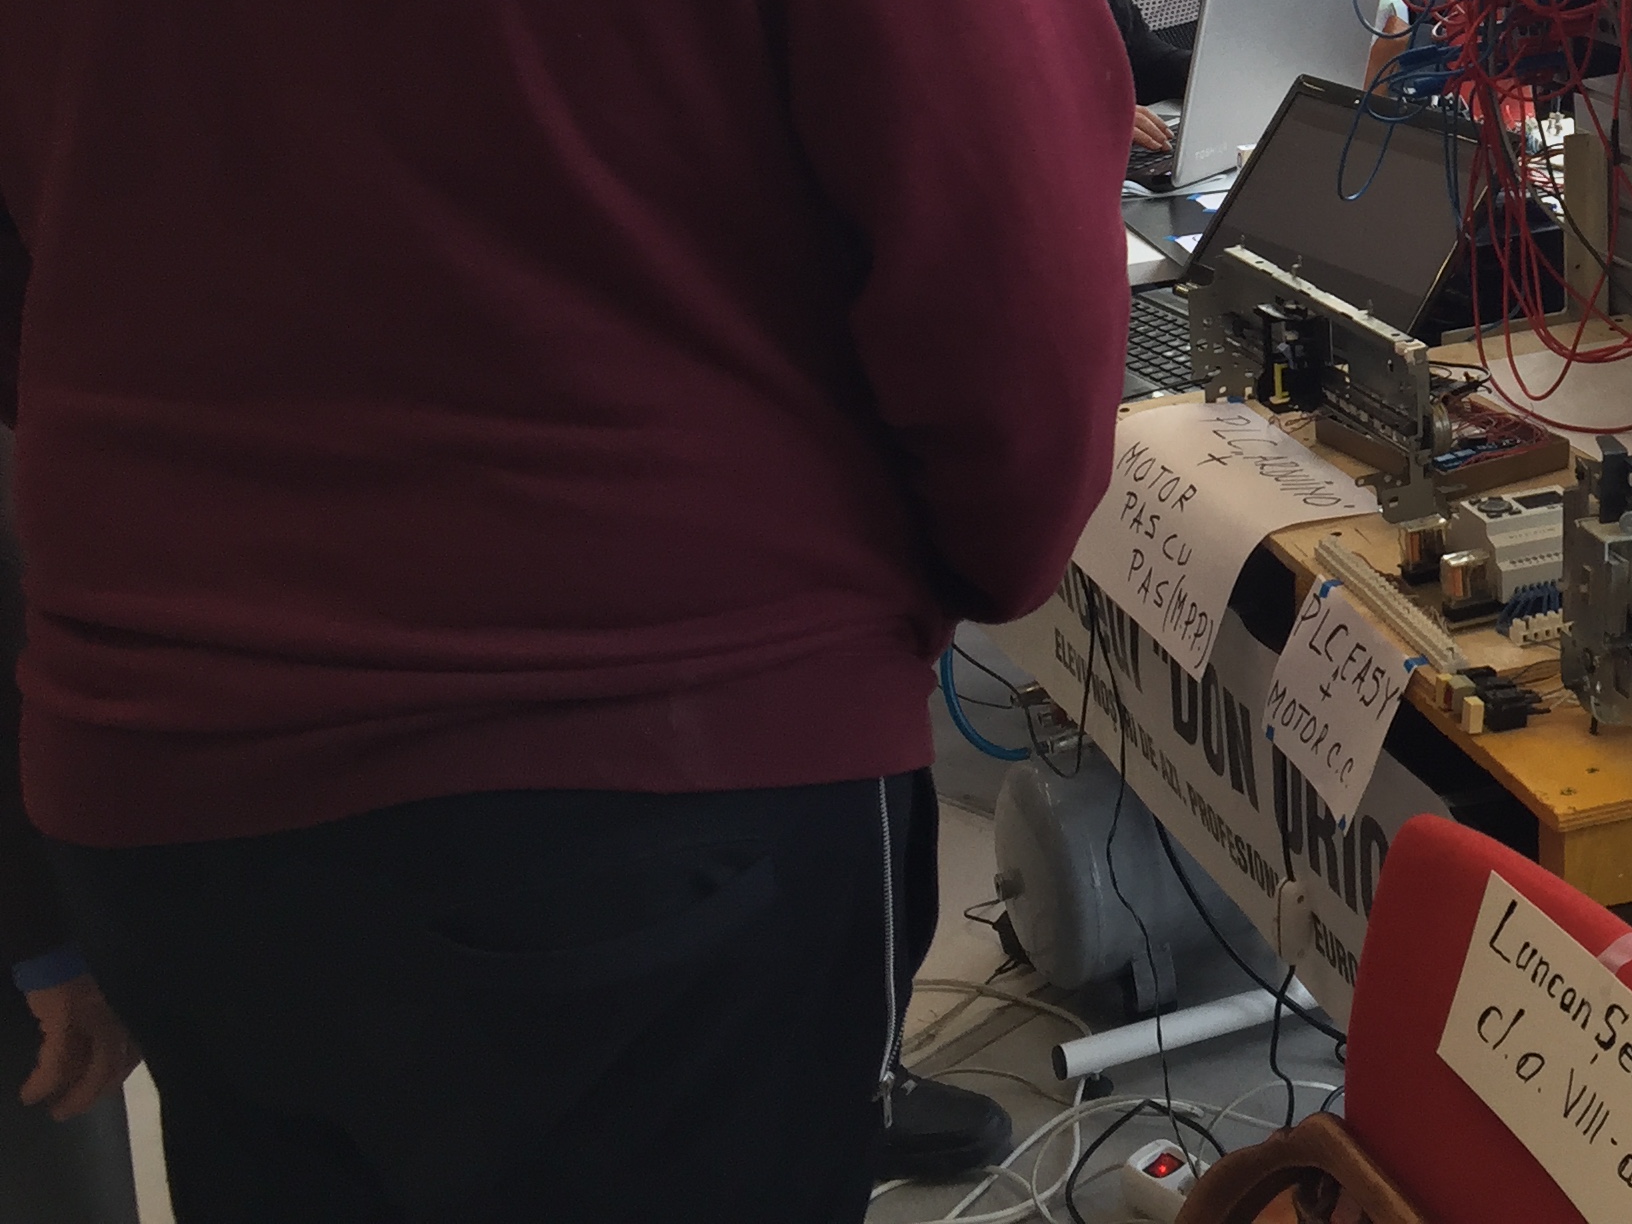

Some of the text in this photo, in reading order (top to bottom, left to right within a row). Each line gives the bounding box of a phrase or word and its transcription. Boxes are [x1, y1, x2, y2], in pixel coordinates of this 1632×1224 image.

[1116, 440, 1198, 513] MOTOR
[1119, 490, 1161, 540] PAS
[1293, 592, 1349, 662] PLC
[1267, 679, 1329, 755] MOTOR
